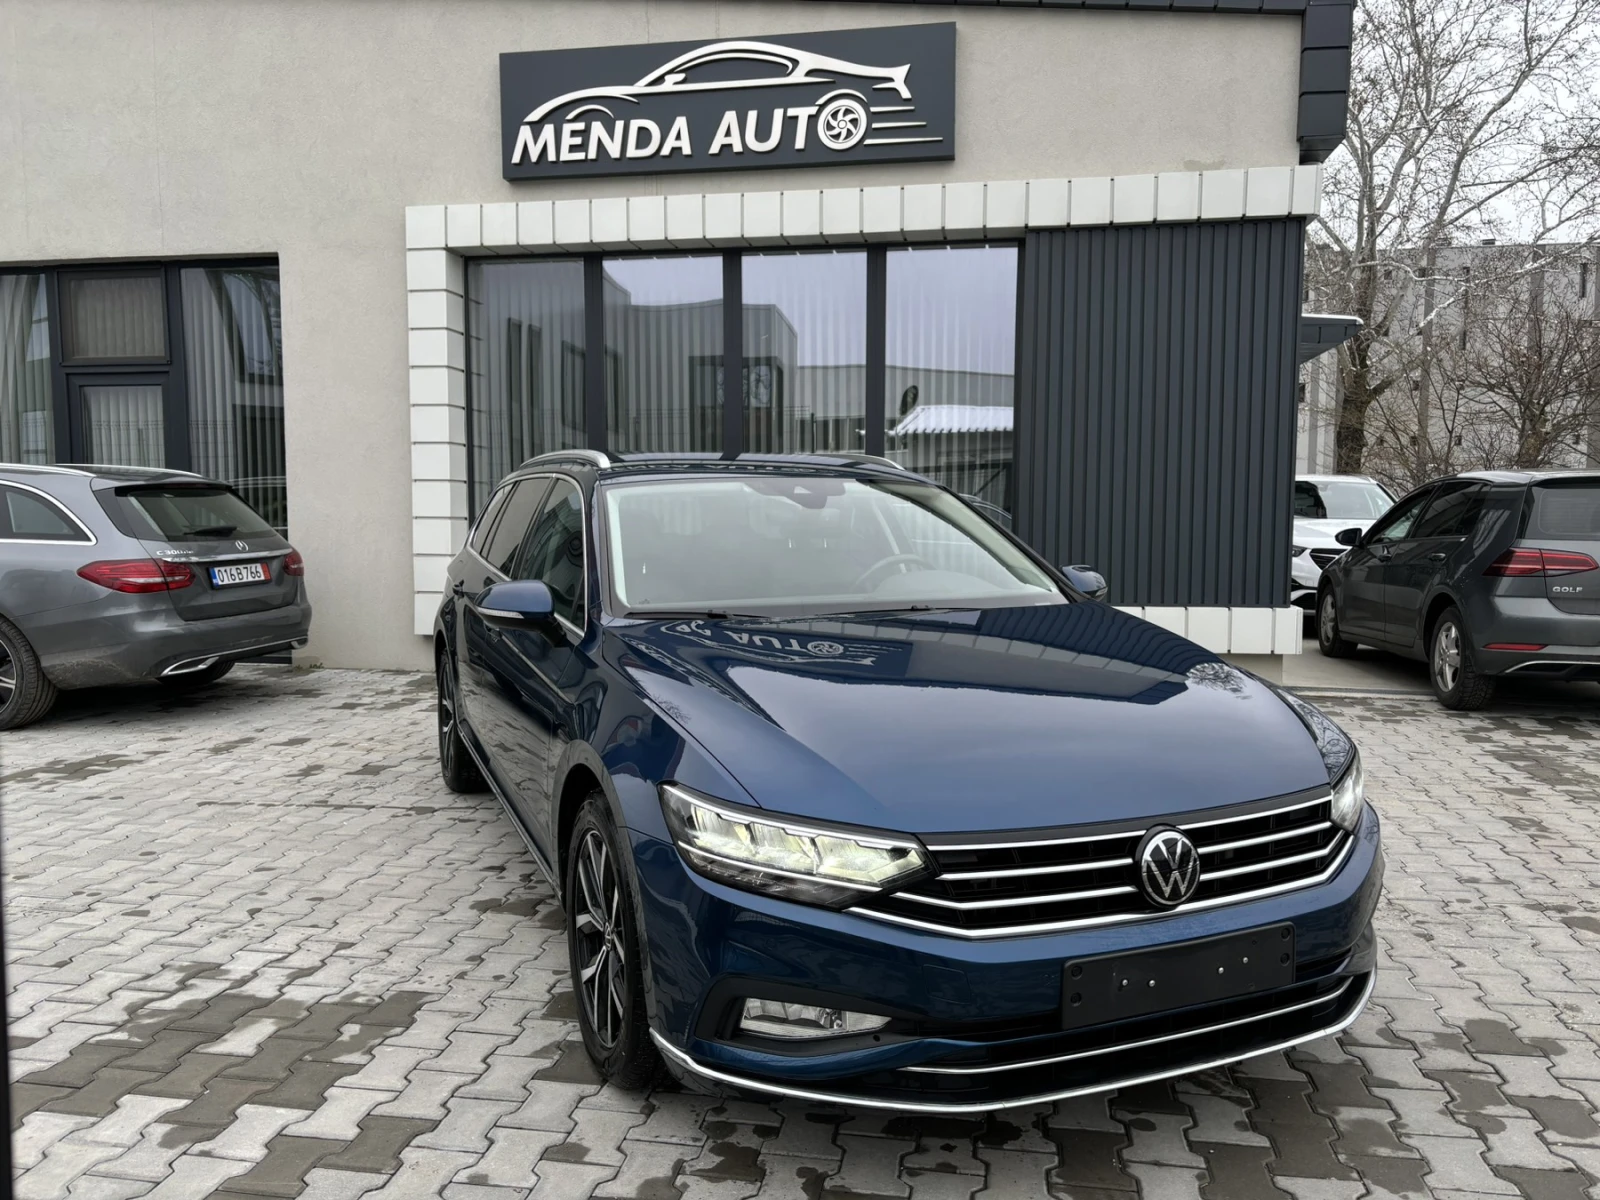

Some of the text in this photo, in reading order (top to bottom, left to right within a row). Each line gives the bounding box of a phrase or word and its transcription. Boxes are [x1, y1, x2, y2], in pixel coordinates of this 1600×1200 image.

[511, 98, 868, 163] MENDA AUTO
[217, 565, 262, 583] 016B766
